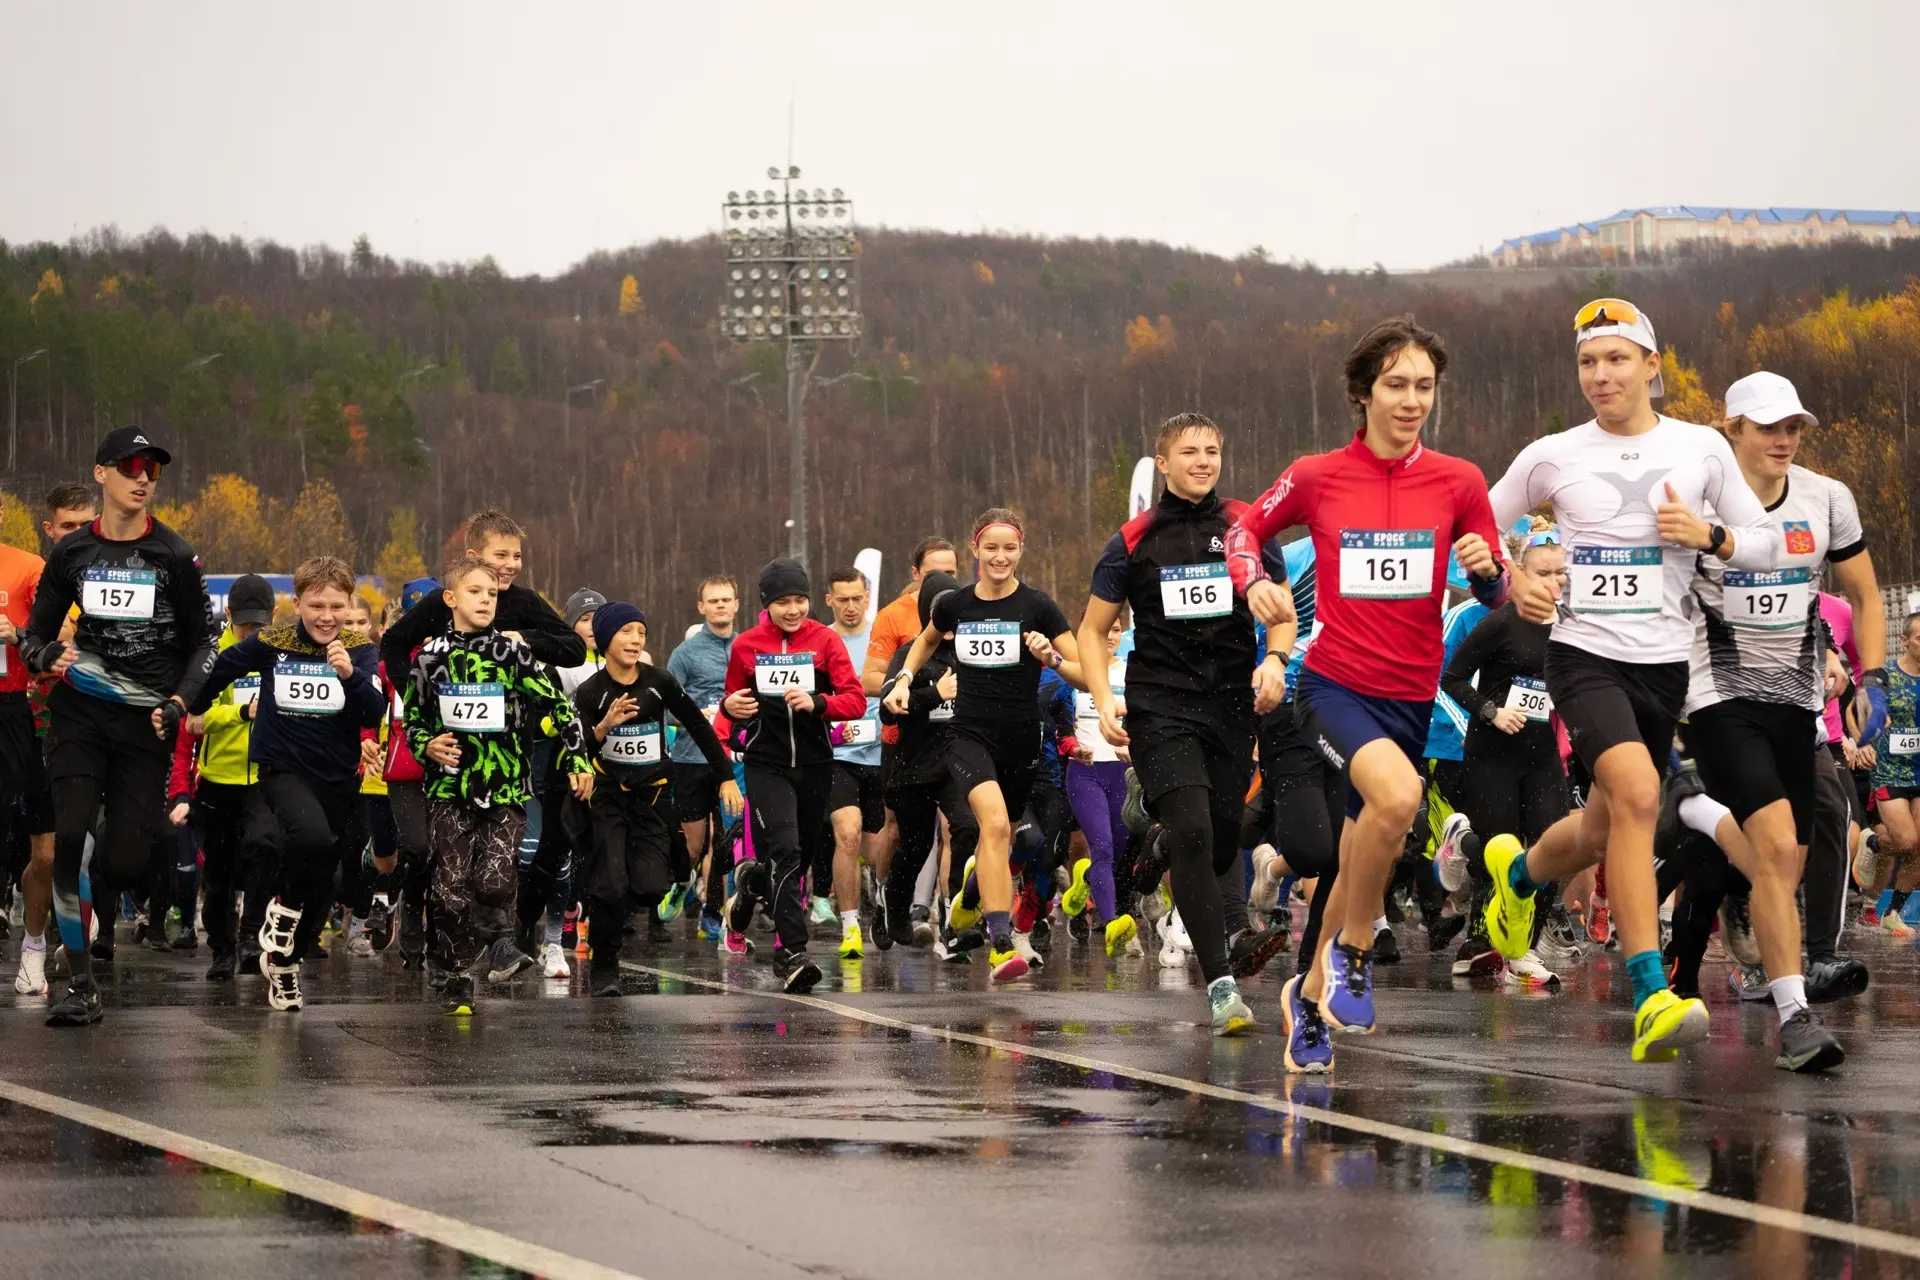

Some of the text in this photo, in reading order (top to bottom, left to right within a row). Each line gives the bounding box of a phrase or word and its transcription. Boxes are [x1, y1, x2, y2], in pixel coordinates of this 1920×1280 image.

[1374, 532, 1405, 542] КРОСС
[1600, 550, 1632, 559] КРОСС
[107, 570, 131, 578] КРОСС
[1185, 566, 1210, 574] КРОСС
[1366, 558, 1408, 581] 161
[1592, 574, 1638, 596] 213
[100, 588, 135, 607] 157
[1179, 585, 1217, 605] 166
[1746, 593, 1788, 614] 197
[969, 640, 1005, 656] 303
[300, 663, 323, 672] КРОСС
[769, 670, 800, 685] 474
[289, 682, 330, 700] 590
[1519, 693, 1546, 711] 306
[452, 702, 488, 719] 472
[613, 740, 647, 755] 466
[1900, 738, 1920, 748] 461
